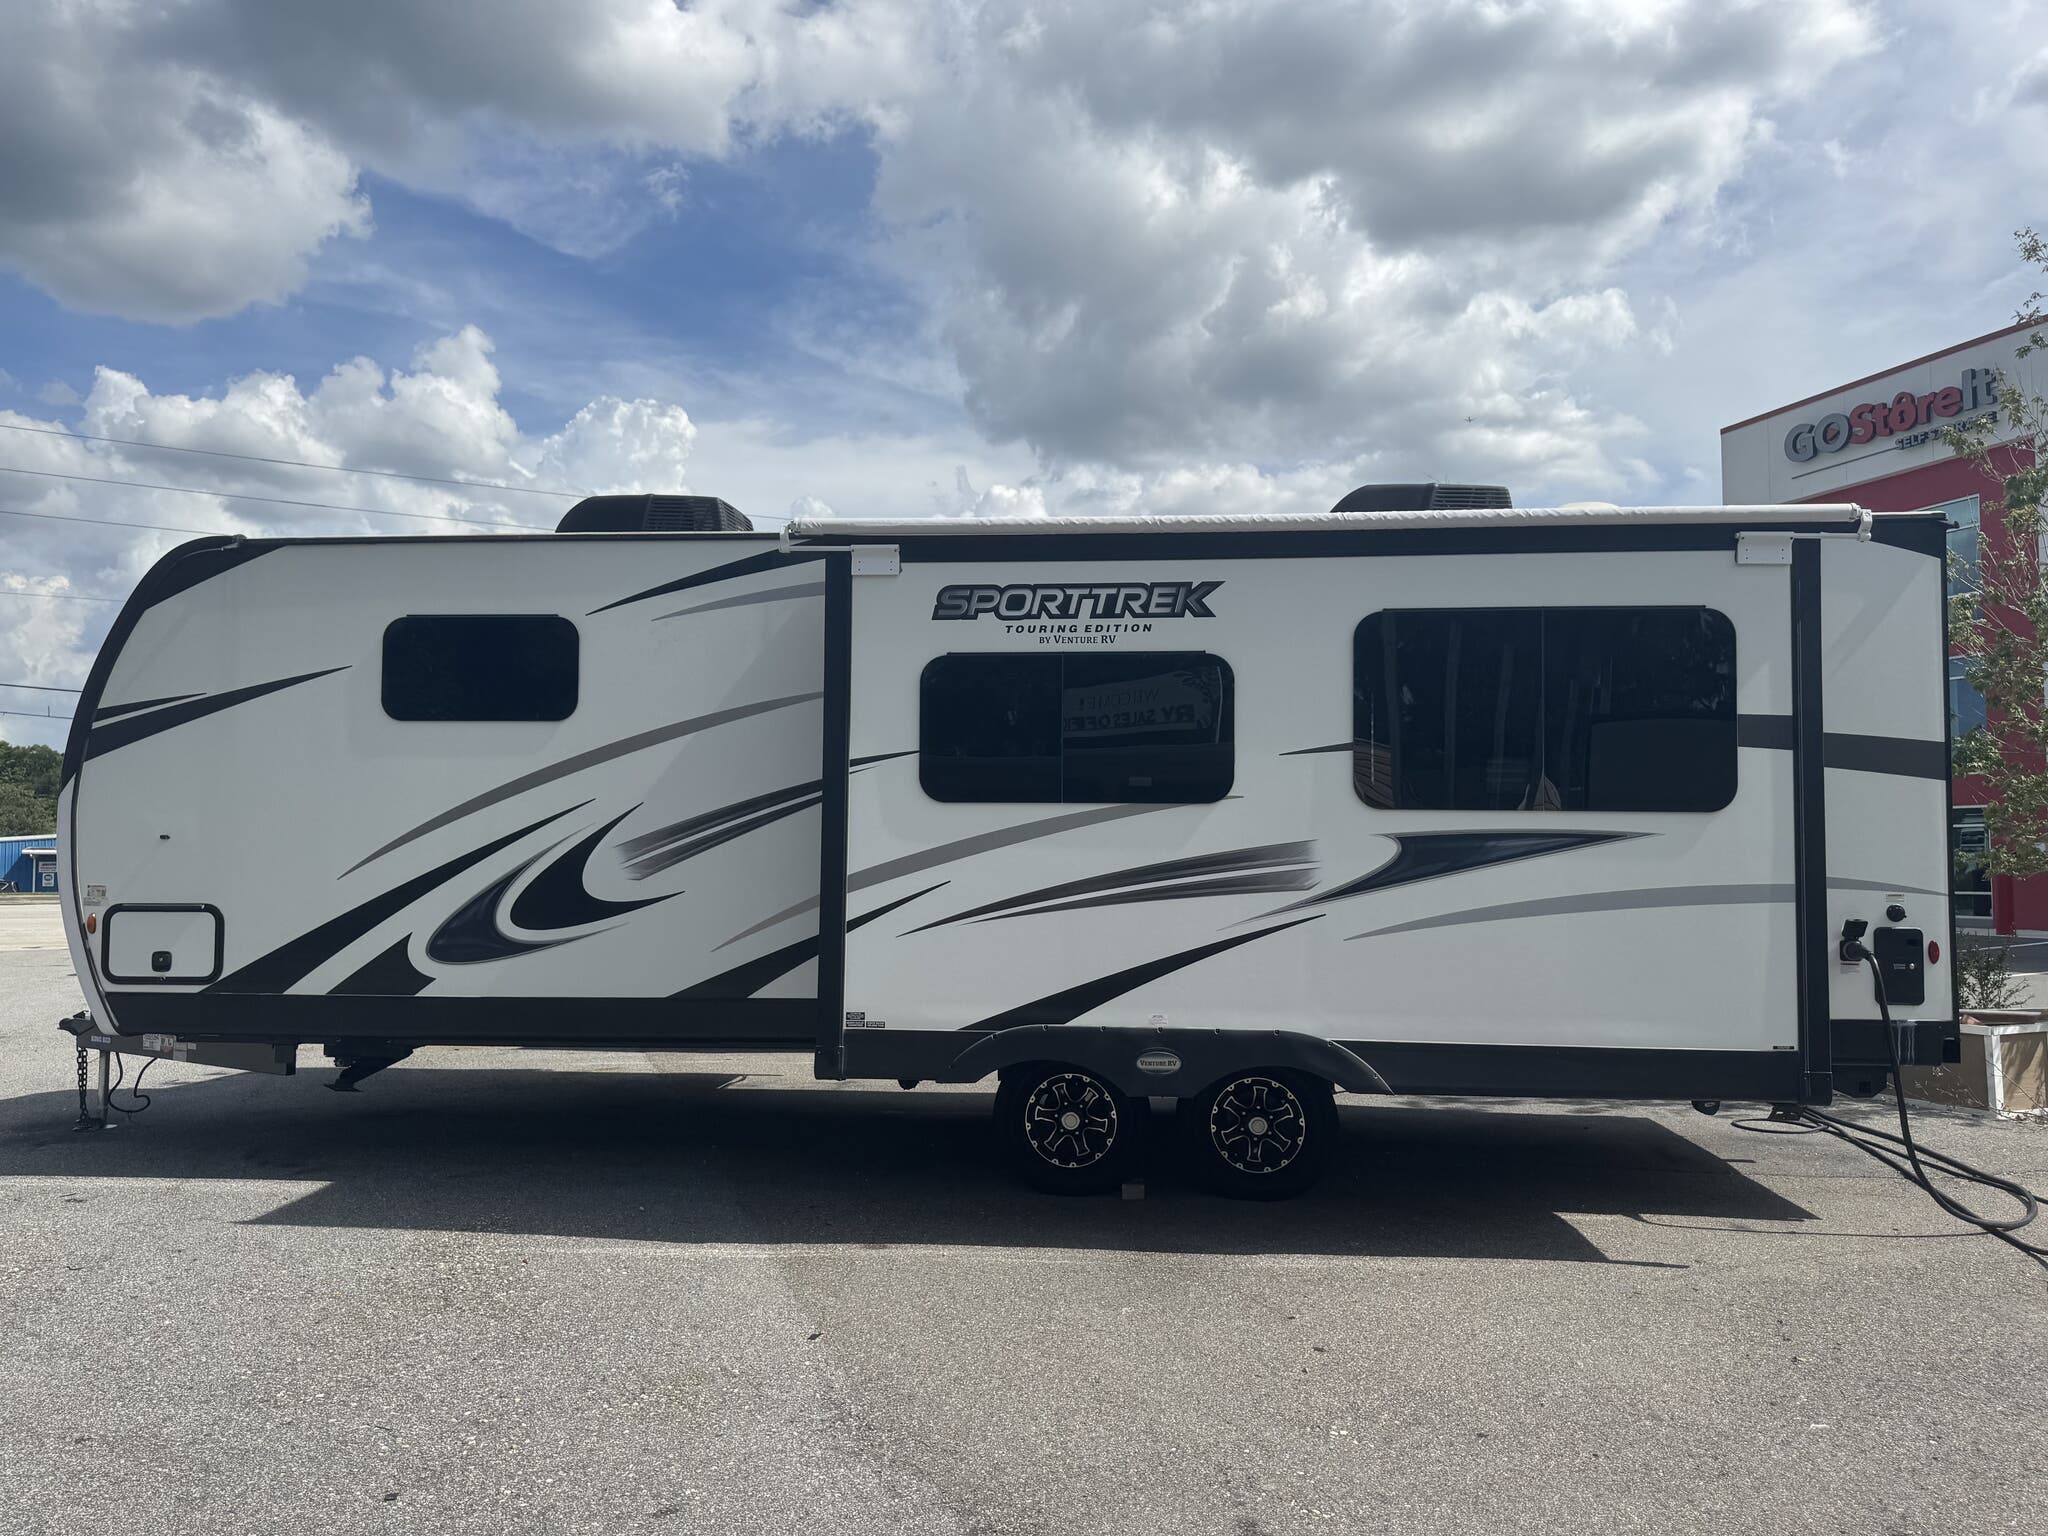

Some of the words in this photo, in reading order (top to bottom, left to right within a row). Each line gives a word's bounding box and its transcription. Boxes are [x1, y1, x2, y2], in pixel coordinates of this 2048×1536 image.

[931, 581, 1226, 621] SPORTTREK
[1005, 624, 1078, 634] TOURING
[1084, 624, 1153, 633] EDITION
[1053, 635, 1099, 644] VENTURE
[1100, 635, 1117, 644] RV
[1167, 1059, 1178, 1067] RV
